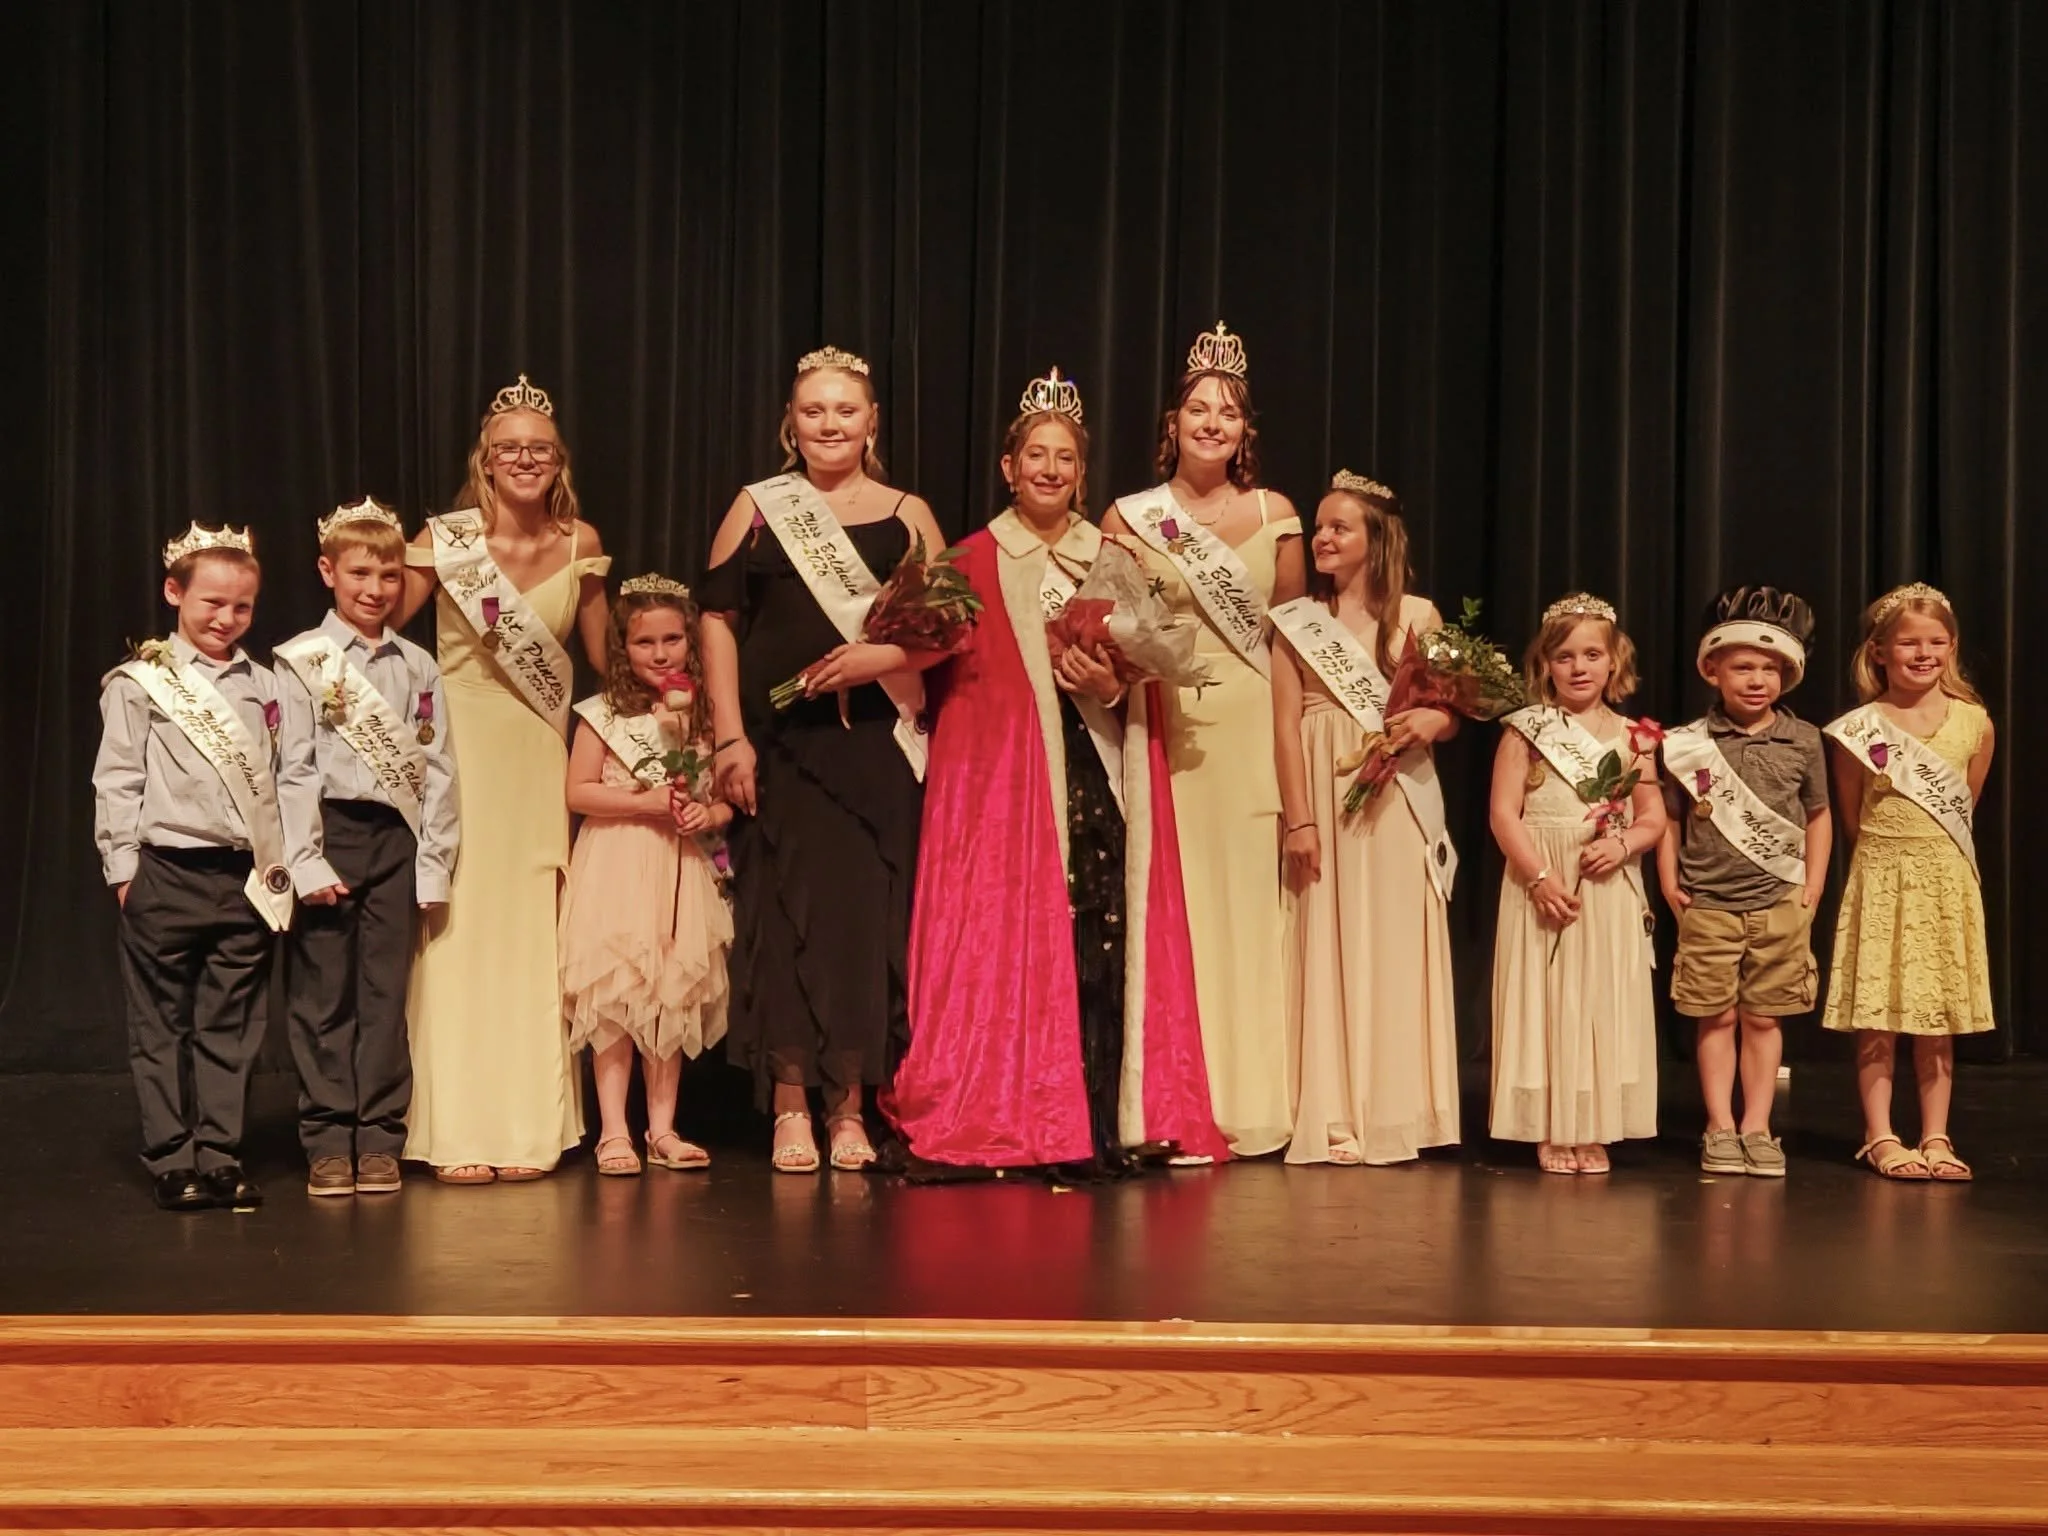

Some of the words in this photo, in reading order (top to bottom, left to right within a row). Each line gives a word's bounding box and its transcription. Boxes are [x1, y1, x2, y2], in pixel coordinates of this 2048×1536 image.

[783, 515, 831, 577] 2025-2026
[800, 511, 822, 538] Miss
[820, 542, 859, 597] Baldwin
[1179, 532, 1208, 561] Miss
[1211, 566, 1258, 630] Baldwin
[523, 641, 565, 702] Princess
[1311, 649, 1370, 712] 2025-2026
[1326, 641, 1354, 673] Miss
[175, 709, 232, 766] 2025-2026
[198, 709, 232, 746] Mister
[234, 752, 259, 797] Baldwin
[346, 726, 401, 788] 2025-2026
[366, 715, 401, 758] Mister
[1913, 763, 1946, 794] Miss
[1916, 788, 1953, 815] 2024
[1740, 810, 1781, 846] Mister
[1741, 836, 1778, 860] 2024
